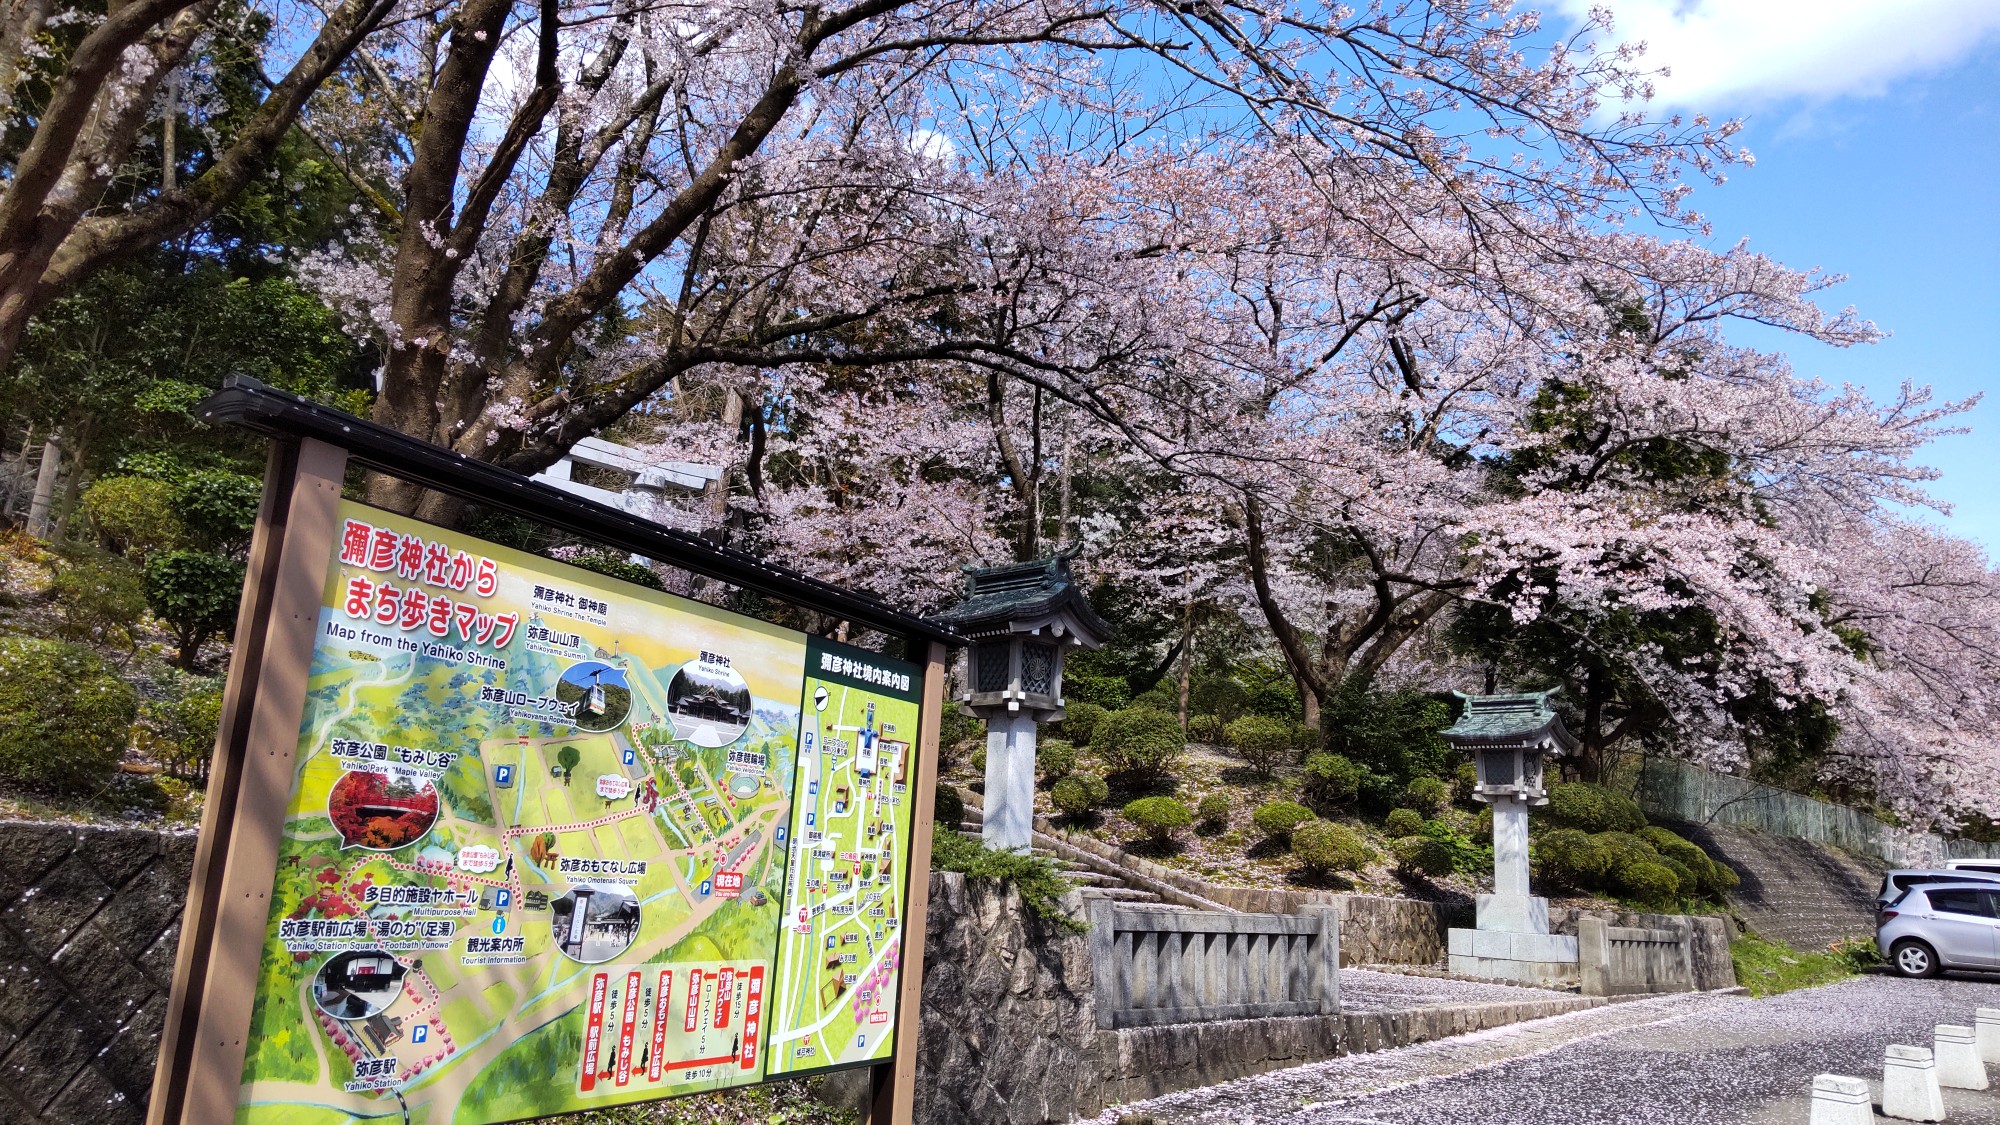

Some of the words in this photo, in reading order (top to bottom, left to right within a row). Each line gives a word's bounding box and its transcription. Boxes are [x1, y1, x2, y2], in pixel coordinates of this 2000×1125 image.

[341, 520, 497, 595] 彌彦神社から
[533, 585, 575, 608] 彌彦神社
[346, 578, 518, 647] まち歩きマップ
[531, 602, 552, 613] Yahiko
[553, 607, 573, 618] Shrine
[575, 612, 586, 622] The
[586, 615, 608, 627] Temple
[326, 621, 356, 641] Map
[360, 629, 393, 647] from
[397, 637, 418, 652] the
[422, 641, 464, 661] Yahiko
[466, 651, 507, 670] Shrine
[527, 625, 581, 649] 弥彦山山頂
[525, 641, 563, 657] Yahikoyama
[563, 650, 587, 661] Summit
[698, 665, 714, 675] Yahiko
[714, 668, 730, 678] Shrine
[820, 652, 911, 692] 彌彦神社境内案内図
[481, 686, 581, 716] 弥彦山ロープウェイ
[509, 708, 548, 723] Yahikoyama
[549, 714, 577, 727] Ropeway
[807, 733, 813, 744] P
[331, 739, 387, 760] 弥彦公園
[625, 751, 633, 764] P
[340, 760, 369, 771] Yahiko
[370, 764, 389, 773] Park
[498, 768, 509, 782] P
[726, 764, 741, 773] Yahiko
[777, 828, 785, 839] P
[559, 857, 648, 876] 弥彦おもてなし広場
[566, 875, 586, 884] Yahiko
[587, 876, 617, 884] Omotenasi
[618, 877, 638, 886] Square
[702, 882, 710, 893] P
[716, 874, 741, 887] 現在地
[365, 885, 479, 904] 多目的施設ヤホール
[499, 892, 509, 906] P
[413, 907, 461, 918] Multipurpose
[462, 907, 477, 916] Hall
[280, 920, 368, 938] 弥彦駅前広場
[286, 941, 315, 951] Yahiko
[317, 941, 347, 950] Station
[349, 941, 378, 951] Square
[467, 937, 525, 954] 観光案内所
[461, 956, 485, 965] Tourist
[486, 955, 527, 964] Information
[724, 971, 734, 1001] 弥彦山
[641, 987, 652, 1029] 徒歩5分
[686, 972, 701, 1030] 弥彦山山頂
[715, 972, 727, 1026] ロープウェイ
[734, 982, 743, 1019] 徒歩15分
[607, 989, 619, 1032] 徒歩5分
[699, 984, 712, 1055] ロープウェイ5分
[744, 978, 762, 1059] 彌彦神社
[415, 1027, 426, 1042] P
[585, 977, 606, 1075] 弥彦駅・駅前広場
[617, 976, 639, 1083] 弥彦公園・もみじ谷
[650, 974, 671, 1079] 弥彦おもてなし広場
[355, 1058, 397, 1078] 弥彦駅
[685, 1068, 712, 1081] 徒歩10分
[345, 1081, 372, 1091] Yahiko
[374, 1079, 402, 1089] Station
